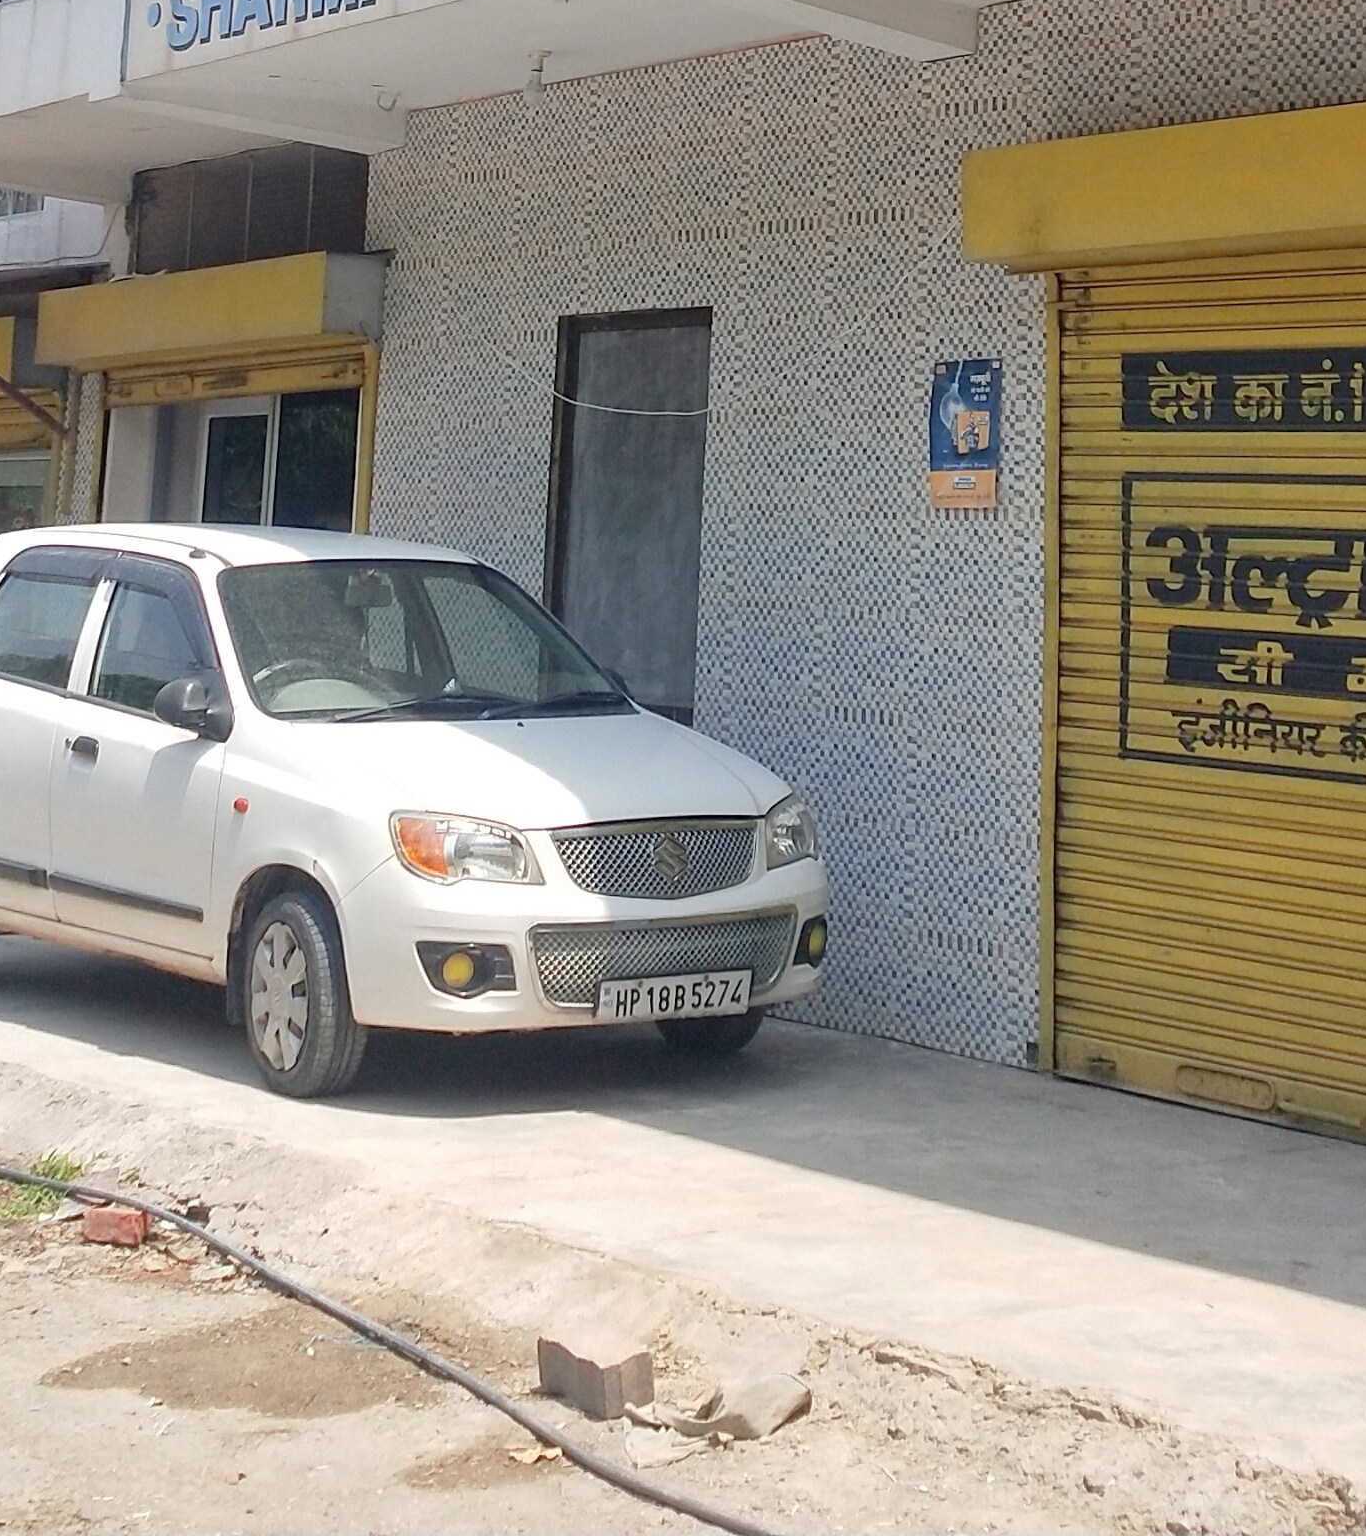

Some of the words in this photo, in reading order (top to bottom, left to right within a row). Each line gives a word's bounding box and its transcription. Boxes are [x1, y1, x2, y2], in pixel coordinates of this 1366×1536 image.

[1147, 360, 1217, 424] देश
[1233, 373, 1290, 422] का
[1170, 697, 1327, 753] इंजीनियर
